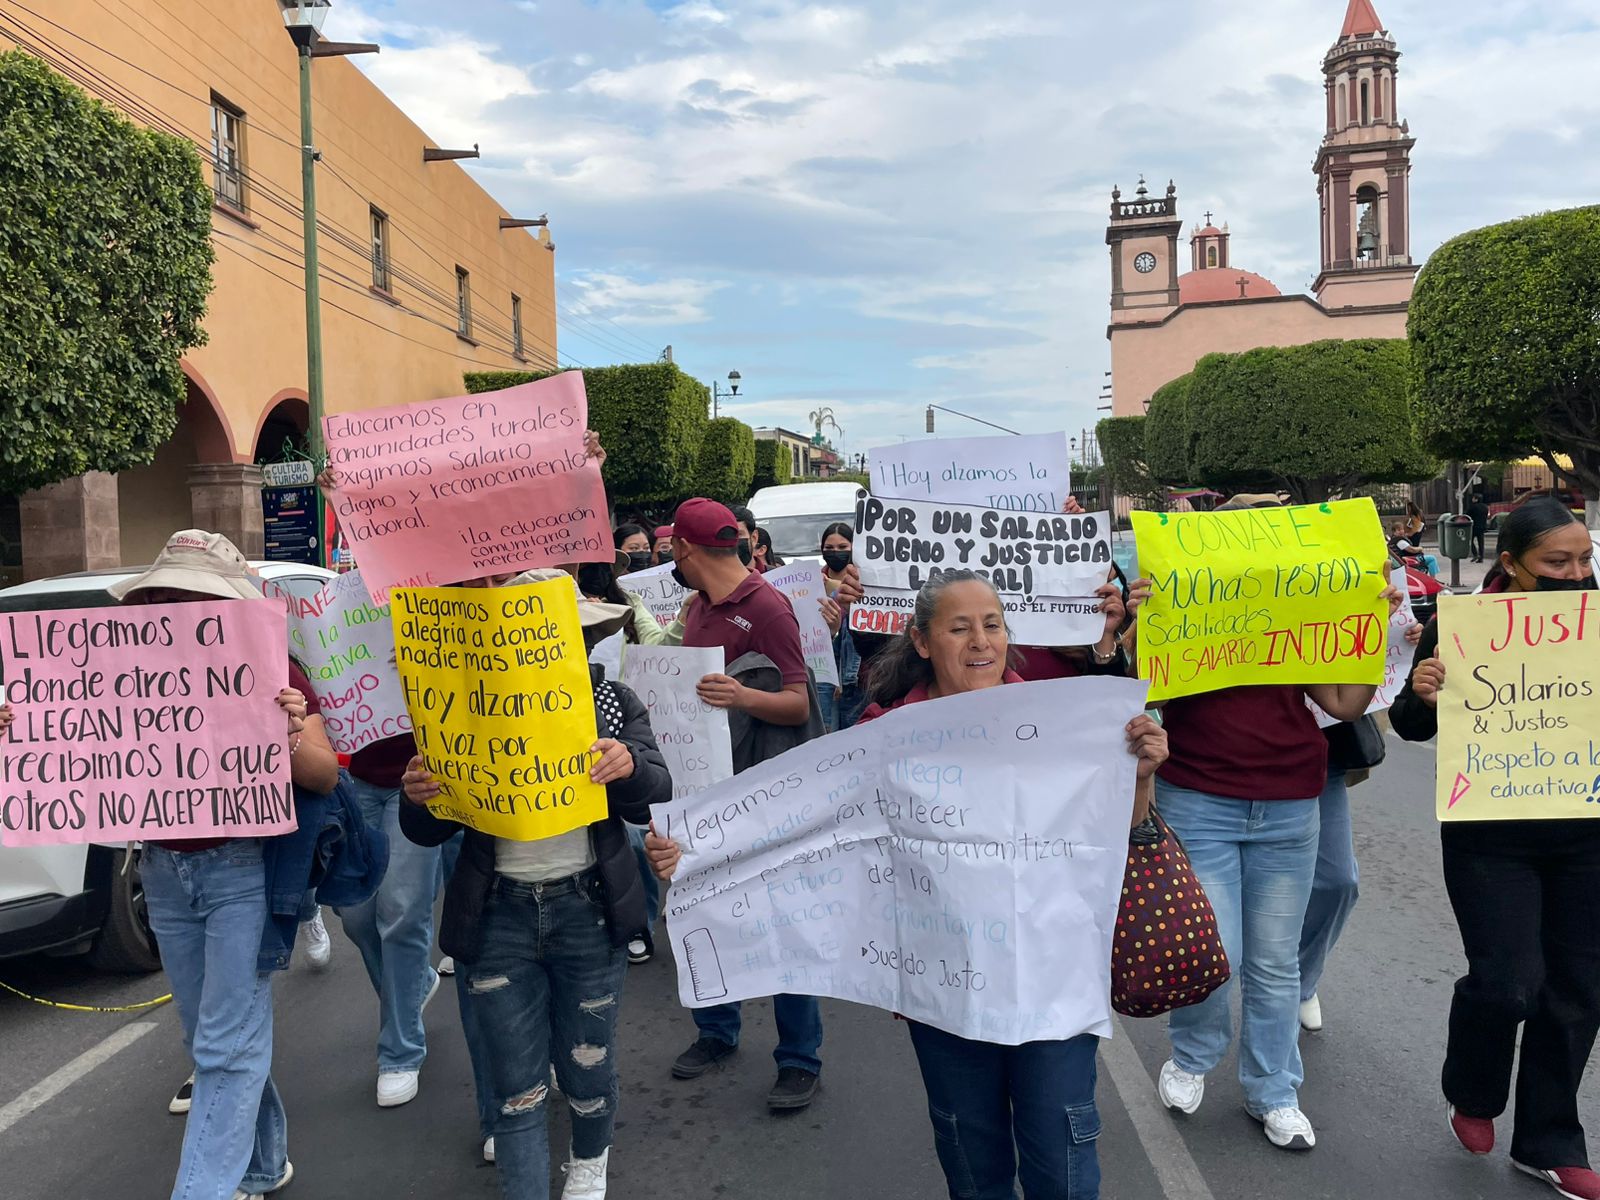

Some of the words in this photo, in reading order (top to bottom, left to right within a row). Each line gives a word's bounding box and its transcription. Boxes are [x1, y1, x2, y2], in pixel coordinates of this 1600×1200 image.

[326, 405, 446, 440] Educamos
[462, 400, 497, 420] en
[271, 463, 308, 476] CULTURA
[273, 474, 309, 485] TURISMO
[333, 456, 433, 490] exigimos
[339, 492, 397, 517] digno
[408, 488, 421, 504] y
[429, 450, 588, 499] reconocimiento
[941, 461, 1018, 481] alzamos
[1029, 461, 1047, 480] la
[499, 506, 597, 538] educación
[855, 488, 918, 535] ¡POR
[931, 510, 973, 535] UN
[979, 510, 1098, 541] SALARIO
[1176, 505, 1322, 557] CONAFE
[469, 527, 572, 558] comunitaria
[472, 550, 535, 568] merece
[543, 531, 605, 558] respeto!
[865, 536, 946, 563] DIGNO
[954, 537, 976, 563] Y
[979, 539, 1111, 567] JUSTICIA
[501, 594, 545, 618] con
[853, 595, 915, 609] NOSOTROS
[1030, 602, 1047, 613] EL
[1490, 592, 1598, 652] Just
[7, 613, 174, 668] Llegamos
[195, 614, 226, 647] a
[472, 629, 484, 648] a
[491, 617, 561, 648] donde
[1178, 636, 1257, 683] SALARIO
[1258, 613, 1383, 667] INJUSTO
[308, 643, 377, 681] cativa.
[400, 643, 460, 669] nadie
[463, 651, 509, 672] mas
[6, 667, 106, 704] donde
[114, 665, 192, 699] otros
[206, 662, 256, 699] NO
[320, 673, 380, 711] abajo
[403, 675, 456, 725] Hoy
[468, 679, 574, 718] alzamos
[1464, 662, 1594, 711] Salarios
[8, 705, 123, 744] LLEGAN
[133, 704, 205, 741] pero
[323, 703, 374, 735] oyo
[653, 727, 694, 746] endo
[1472, 714, 1489, 735] &
[1500, 709, 1570, 734] Justos
[4, 745, 173, 784] recibimos
[176, 742, 211, 780] lo
[219, 742, 283, 785] que
[440, 730, 478, 757] voz
[488, 734, 534, 765] por
[815, 747, 867, 774] con
[1015, 723, 1039, 742] a
[1465, 740, 1556, 778] Respeto
[1563, 751, 1580, 767] a
[508, 750, 594, 788] educan
[895, 757, 964, 803] llega
[98, 791, 137, 830] NO
[139, 776, 293, 829] ACEPTARÍAN
[936, 832, 1080, 875] garantizar
[731, 892, 751, 918] el
[867, 863, 895, 885] de
[910, 868, 932, 896] la
[868, 939, 926, 977] Sueldo
[937, 958, 987, 992] Justo
